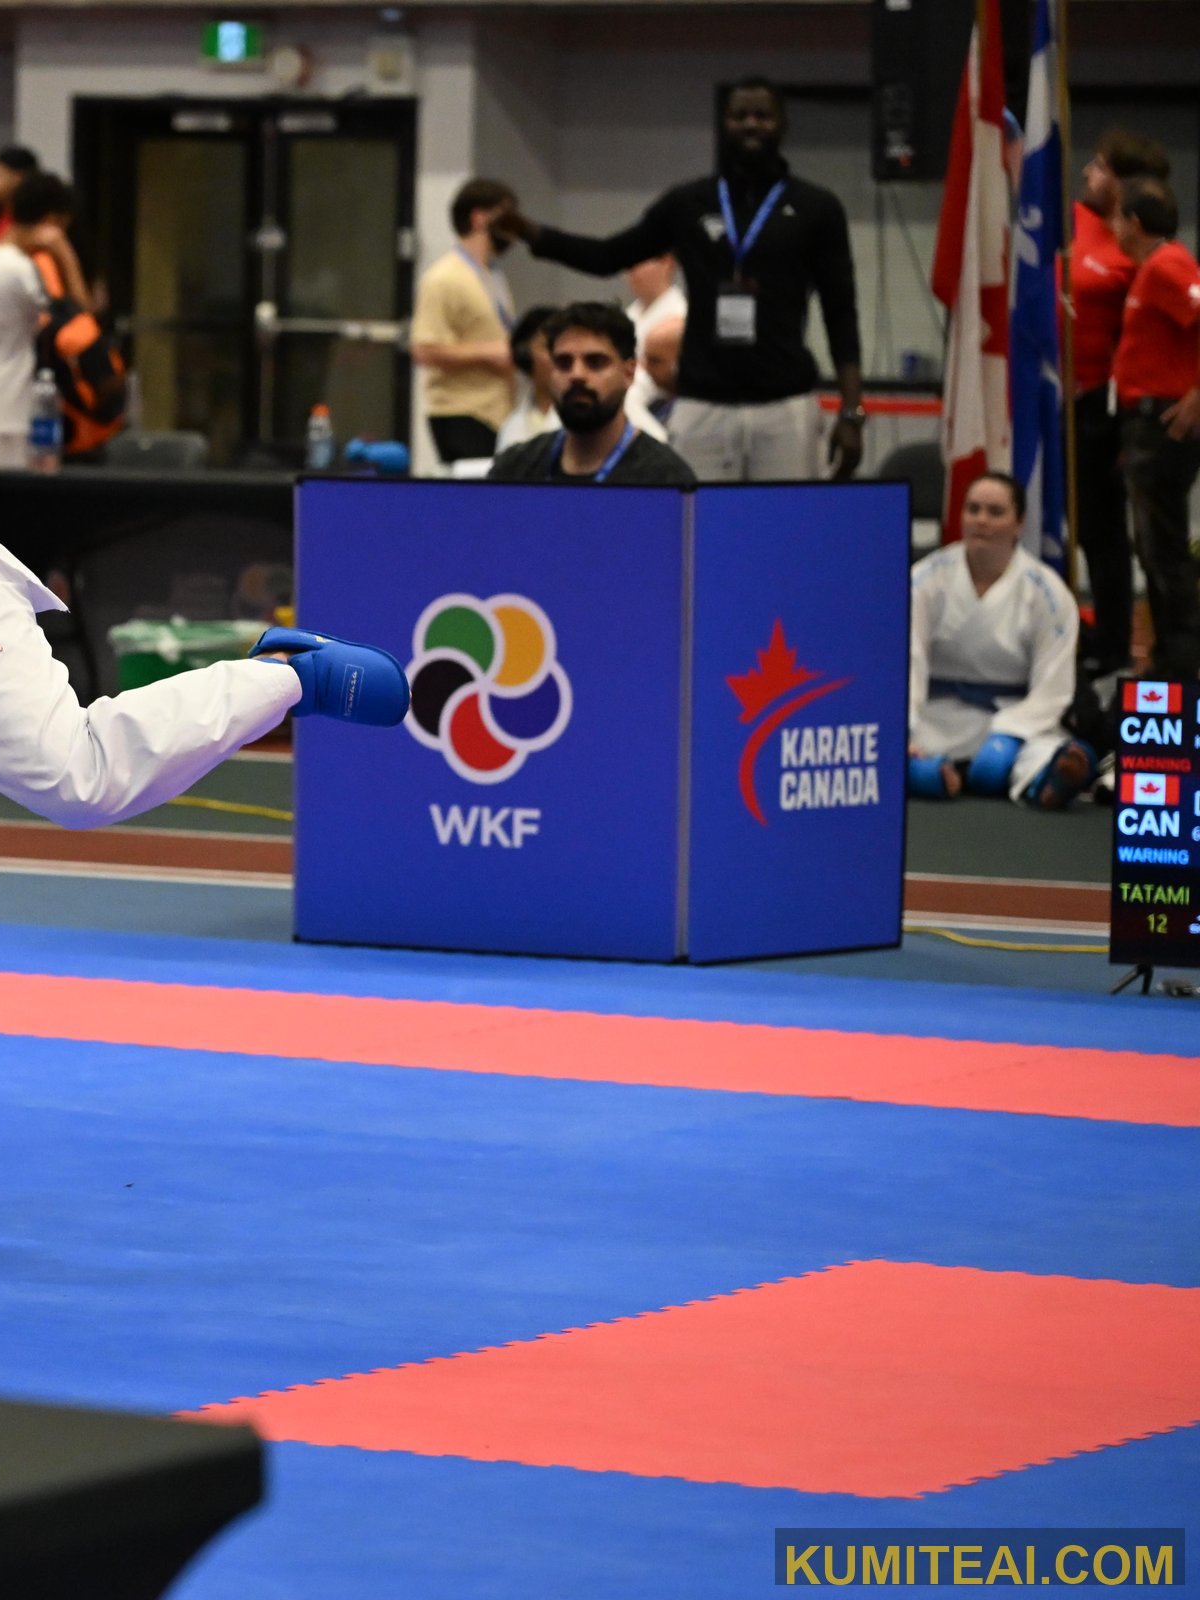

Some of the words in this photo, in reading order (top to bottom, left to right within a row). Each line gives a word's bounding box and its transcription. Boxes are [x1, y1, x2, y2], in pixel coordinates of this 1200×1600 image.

[781, 723, 879, 769] KARATE
[1120, 716, 1183, 746] CAN
[1121, 755, 1191, 772] WARNING
[780, 765, 880, 811] CANADA
[429, 803, 541, 849] WKF
[1117, 808, 1180, 838] CAN
[1118, 846, 1189, 865] WARNING
[1118, 882, 1190, 906] TATAMI
[1146, 913, 1168, 934] 12
